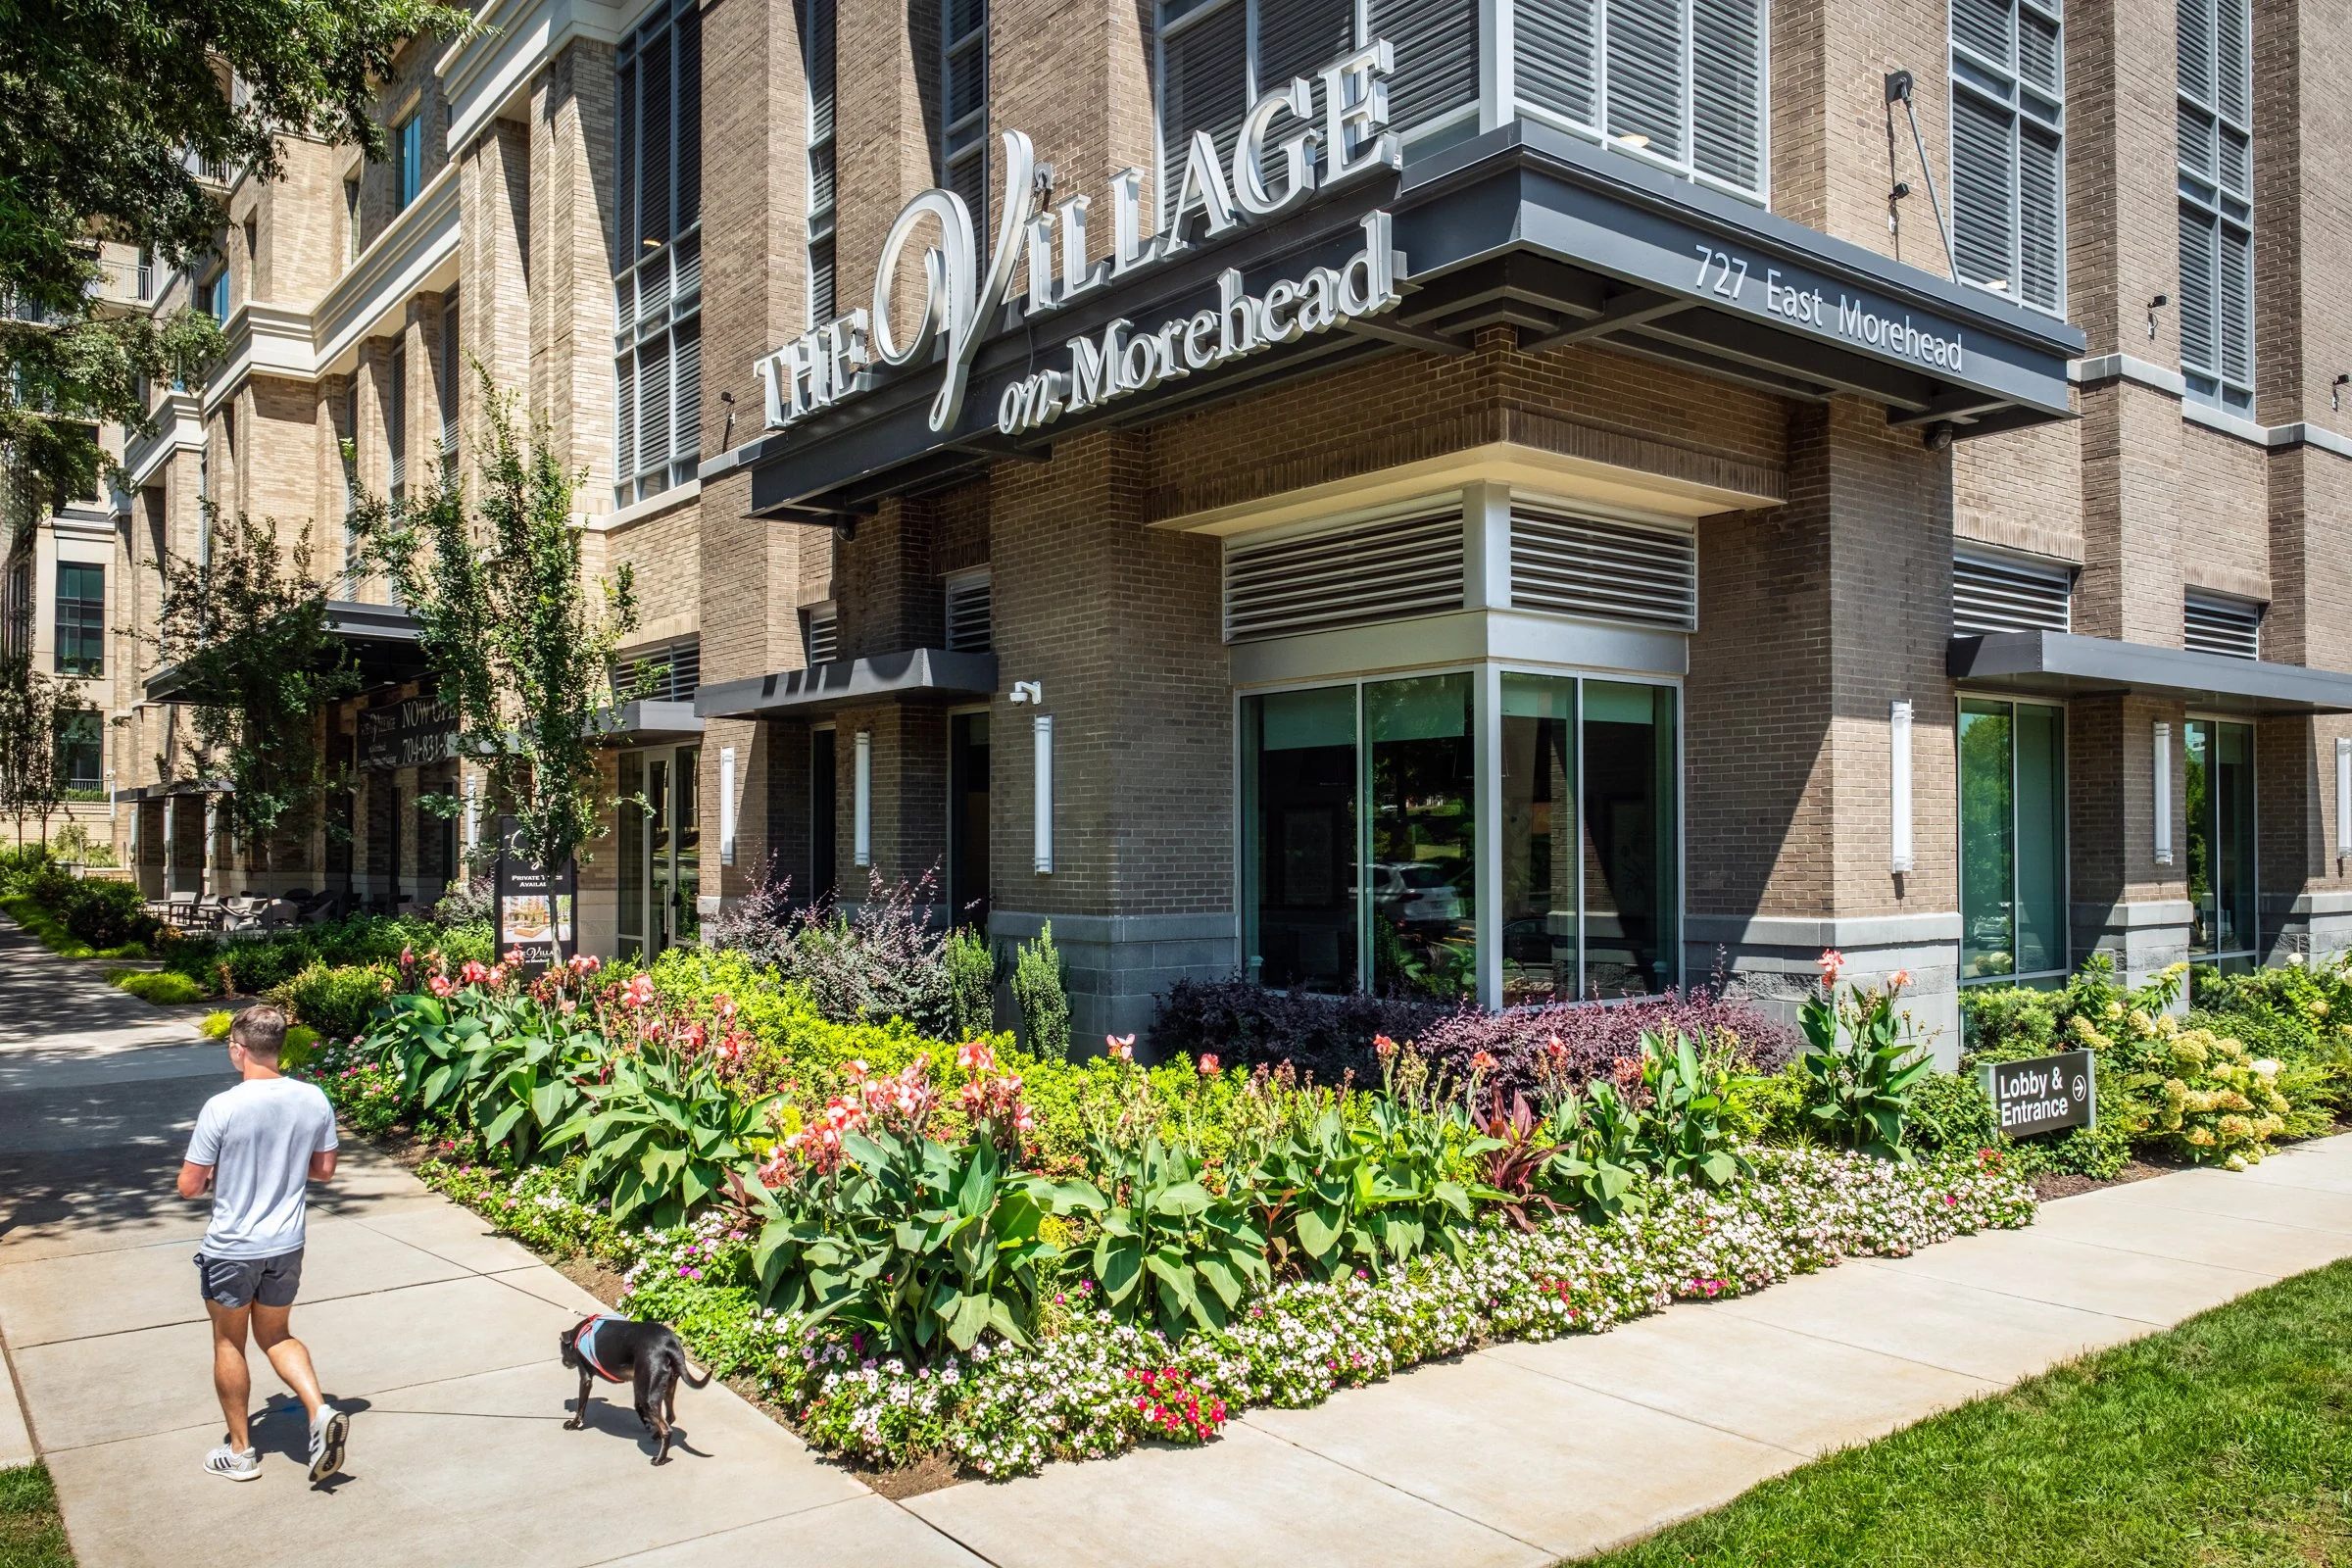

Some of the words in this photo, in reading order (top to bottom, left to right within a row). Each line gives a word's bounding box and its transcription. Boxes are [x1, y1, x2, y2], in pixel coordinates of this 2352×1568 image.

[755, 307, 868, 430] THE
[874, 38, 1402, 432] VILLAGE
[998, 368, 1062, 435] on
[1065, 210, 1402, 414] Morehead
[1694, 244, 1748, 300] 727
[1767, 269, 1824, 327] East
[1838, 294, 1963, 373] Morehead
[402, 700, 429, 729] NOW
[2000, 1070, 2048, 1100] Lobby
[2051, 1066, 2063, 1090] &
[2000, 1097, 2069, 1127] Entrance
